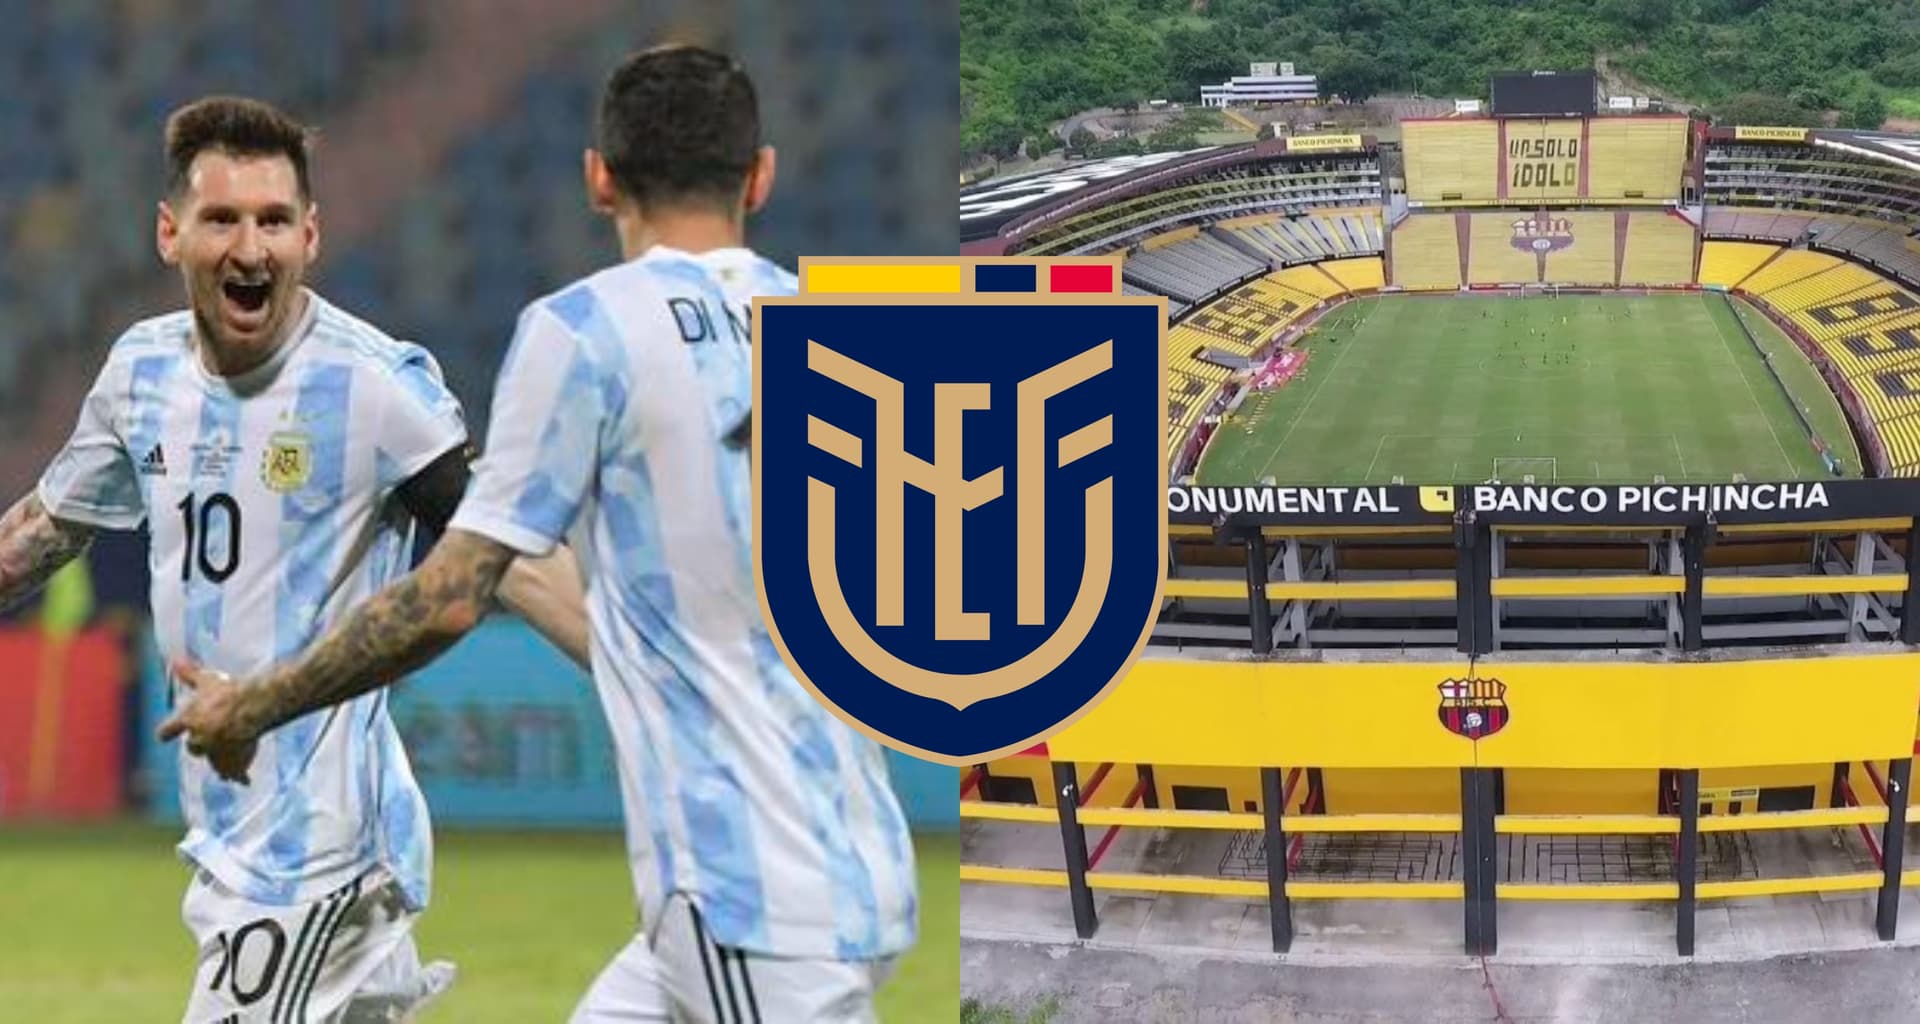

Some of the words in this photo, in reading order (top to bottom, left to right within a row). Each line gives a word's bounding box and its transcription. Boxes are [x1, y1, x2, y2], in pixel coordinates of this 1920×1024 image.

[1526, 139, 1577, 158] SOLO
[667, 297, 717, 342] DI
[1168, 486, 1400, 513] ONUMENTAL
[1473, 486, 1607, 512] BANCO
[1618, 482, 1829, 513] PICHINCHA
[177, 491, 241, 584] 10
